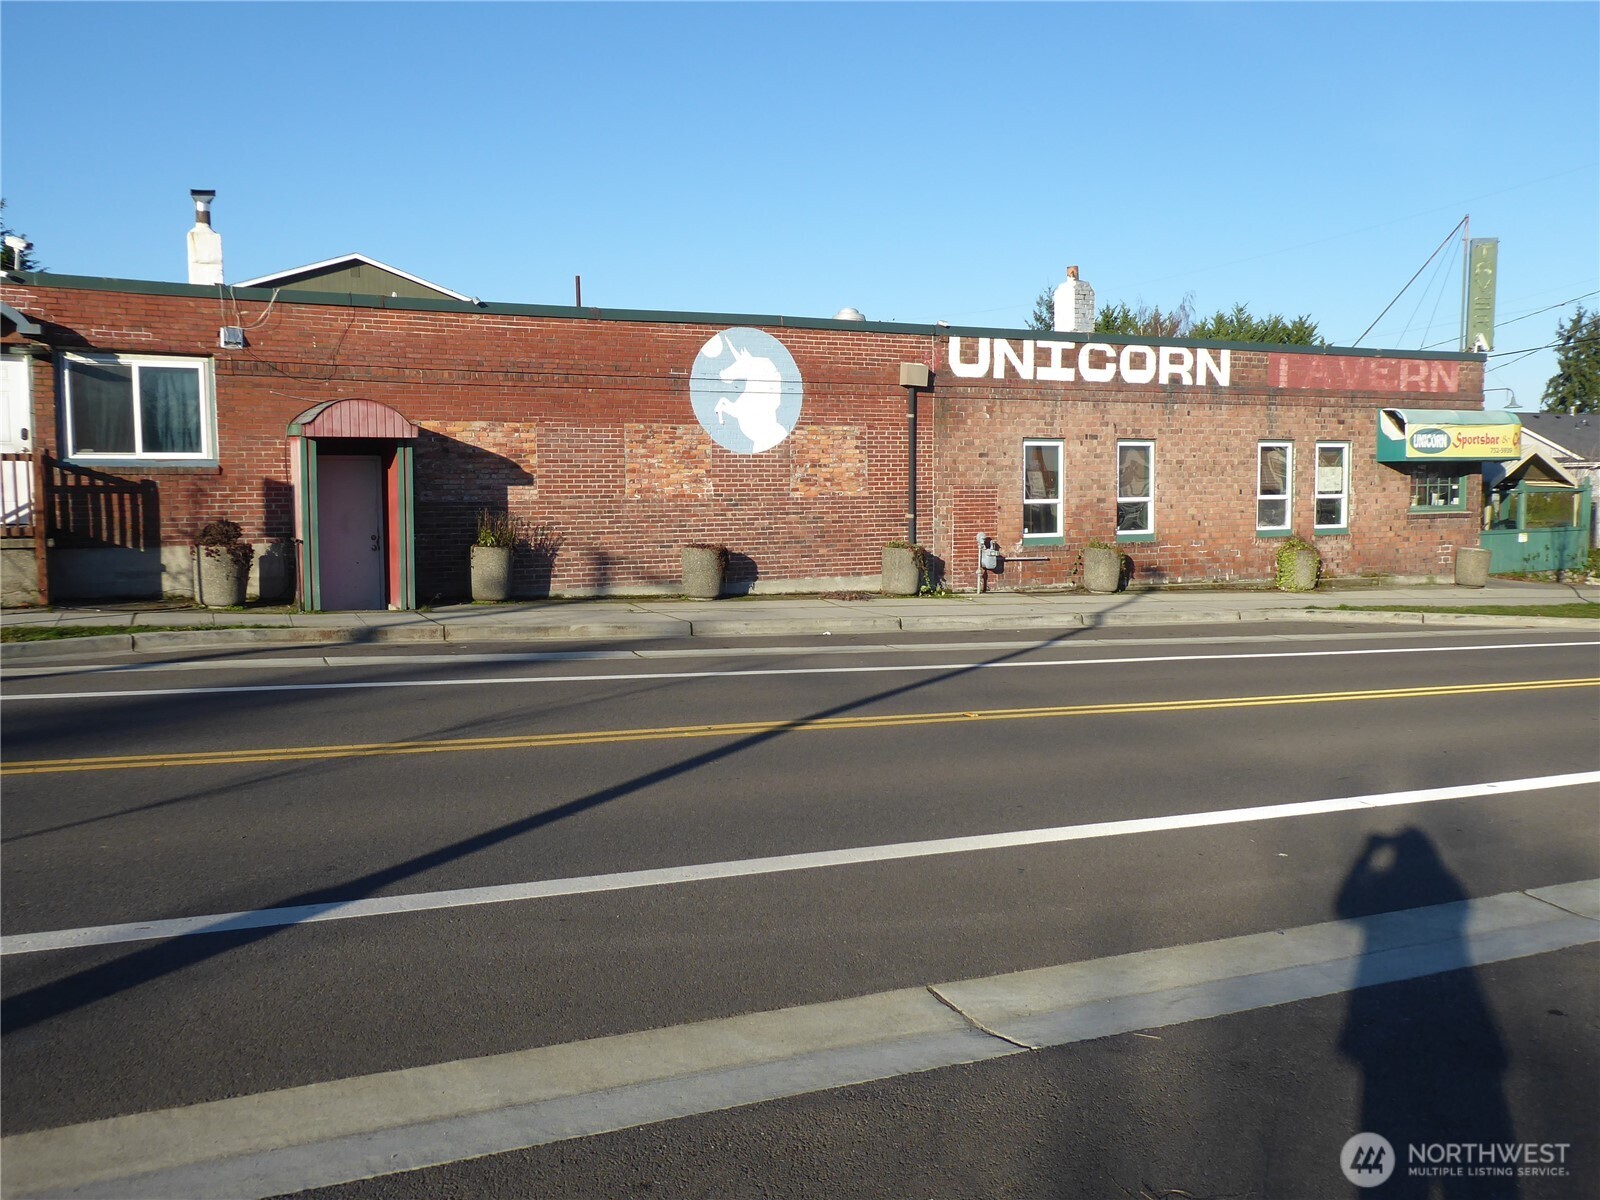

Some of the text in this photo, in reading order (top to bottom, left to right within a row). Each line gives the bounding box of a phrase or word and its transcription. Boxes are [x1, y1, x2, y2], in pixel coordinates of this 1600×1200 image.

[949, 336, 1231, 387] UNICORN
[1413, 433, 1448, 449] UNICORN
[1452, 432, 1500, 449] Sportsbar
